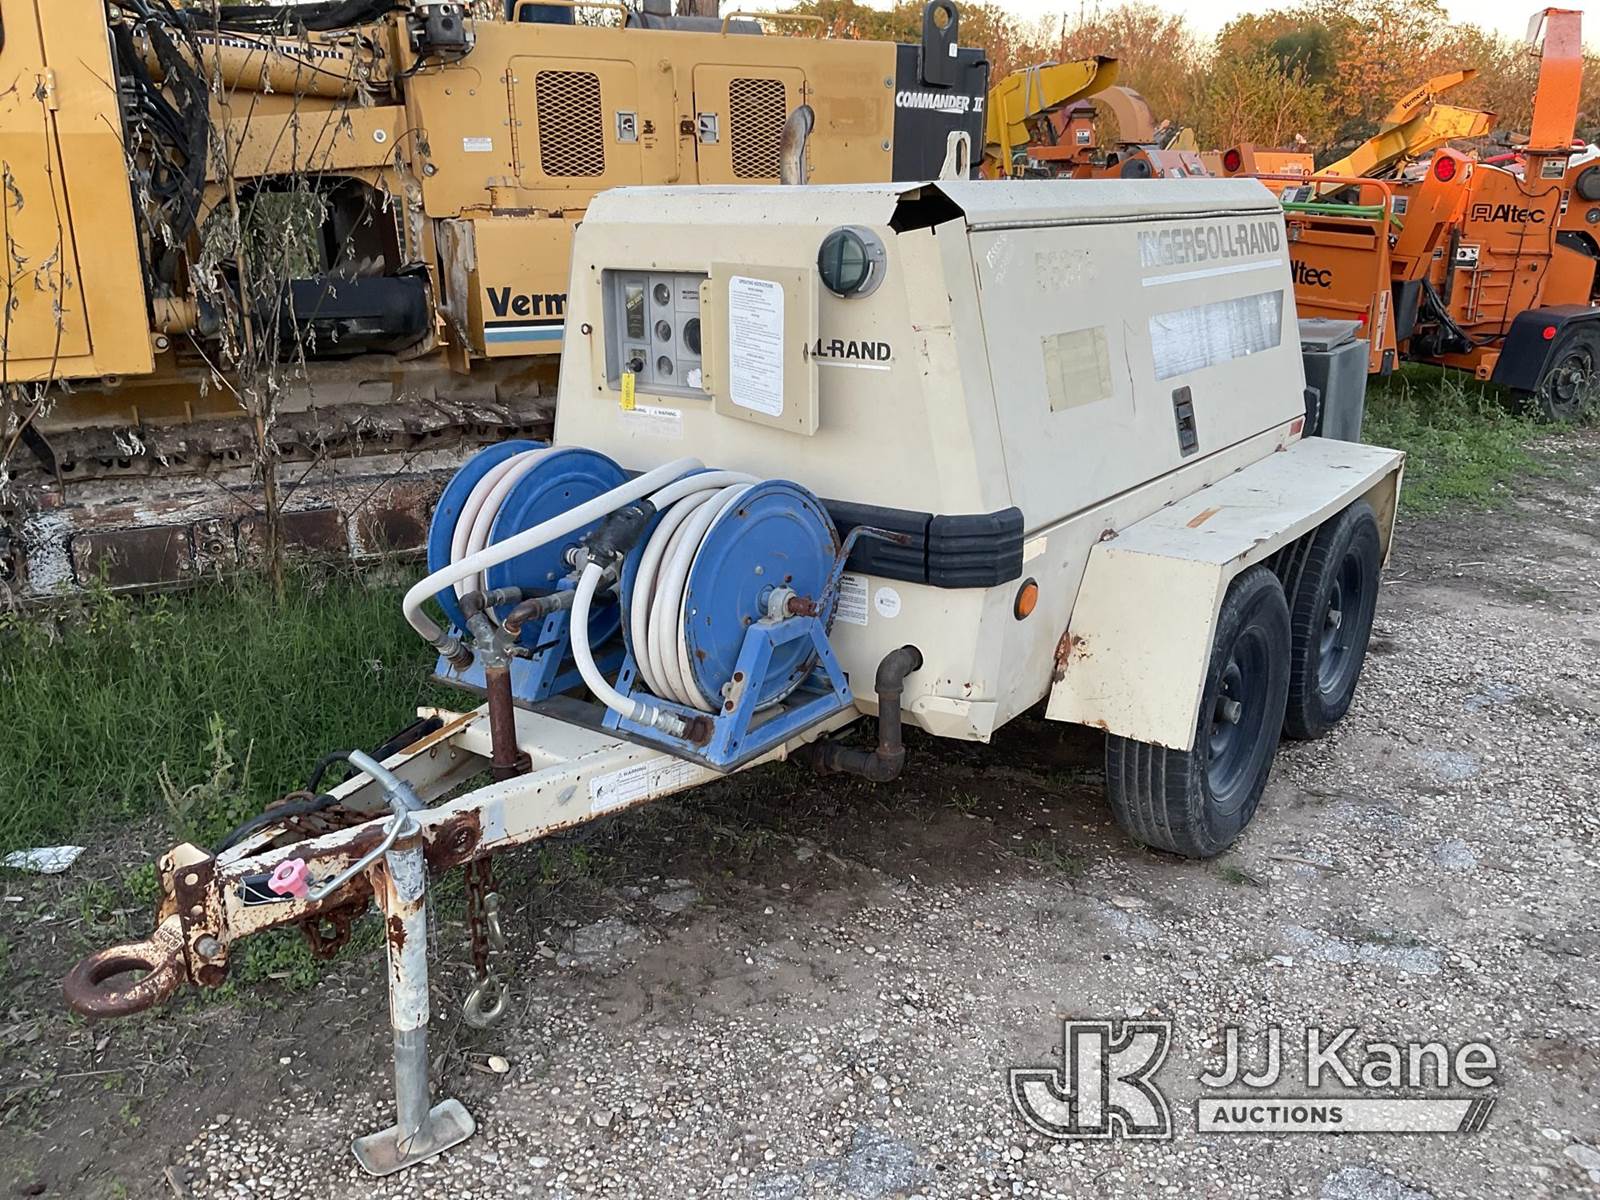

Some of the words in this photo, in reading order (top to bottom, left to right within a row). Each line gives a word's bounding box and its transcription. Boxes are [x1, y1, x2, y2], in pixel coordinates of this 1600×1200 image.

[895, 91, 970, 111] COMMANDER
[1401, 89, 1426, 109] Vermeer
[1491, 203, 1546, 223] Altec
[1137, 221, 1281, 268] INGERSOLL-RAND
